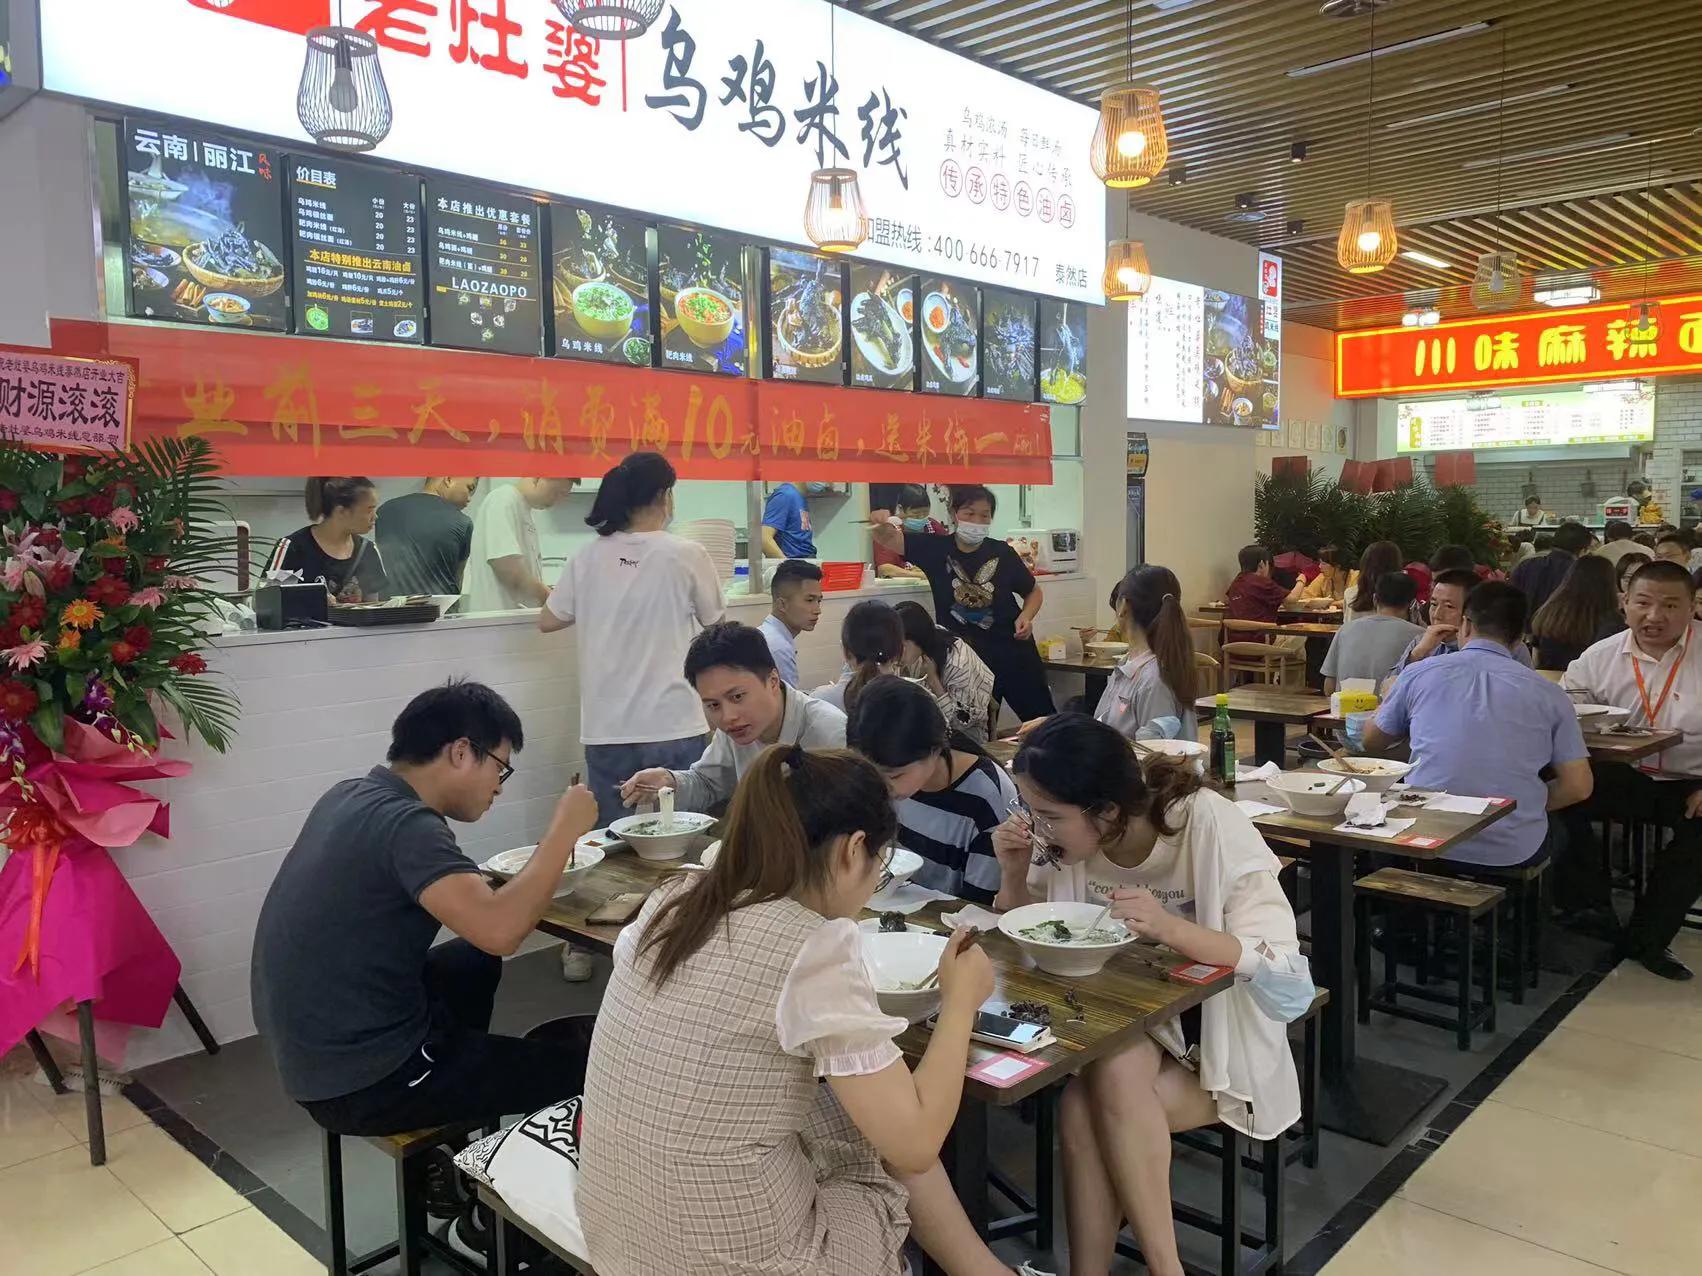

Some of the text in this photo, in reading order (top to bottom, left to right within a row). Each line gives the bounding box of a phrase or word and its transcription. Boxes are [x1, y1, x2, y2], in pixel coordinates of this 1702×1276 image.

[644, 4, 909, 191] 乌鸡米线
[296, 166, 337, 186] 价目表
[941, 161, 1075, 225] 传承特色油卤
[437, 197, 531, 226] 本店推出优惠套餐
[309, 249, 412, 273] 本店特别推出云南油卤
[452, 276, 528, 298] LAOZAOPO
[1055, 263, 1088, 289] 泰然店
[561, 337, 604, 354] 乌鸡米线
[0, 376, 121, 429] 财源滚滚
